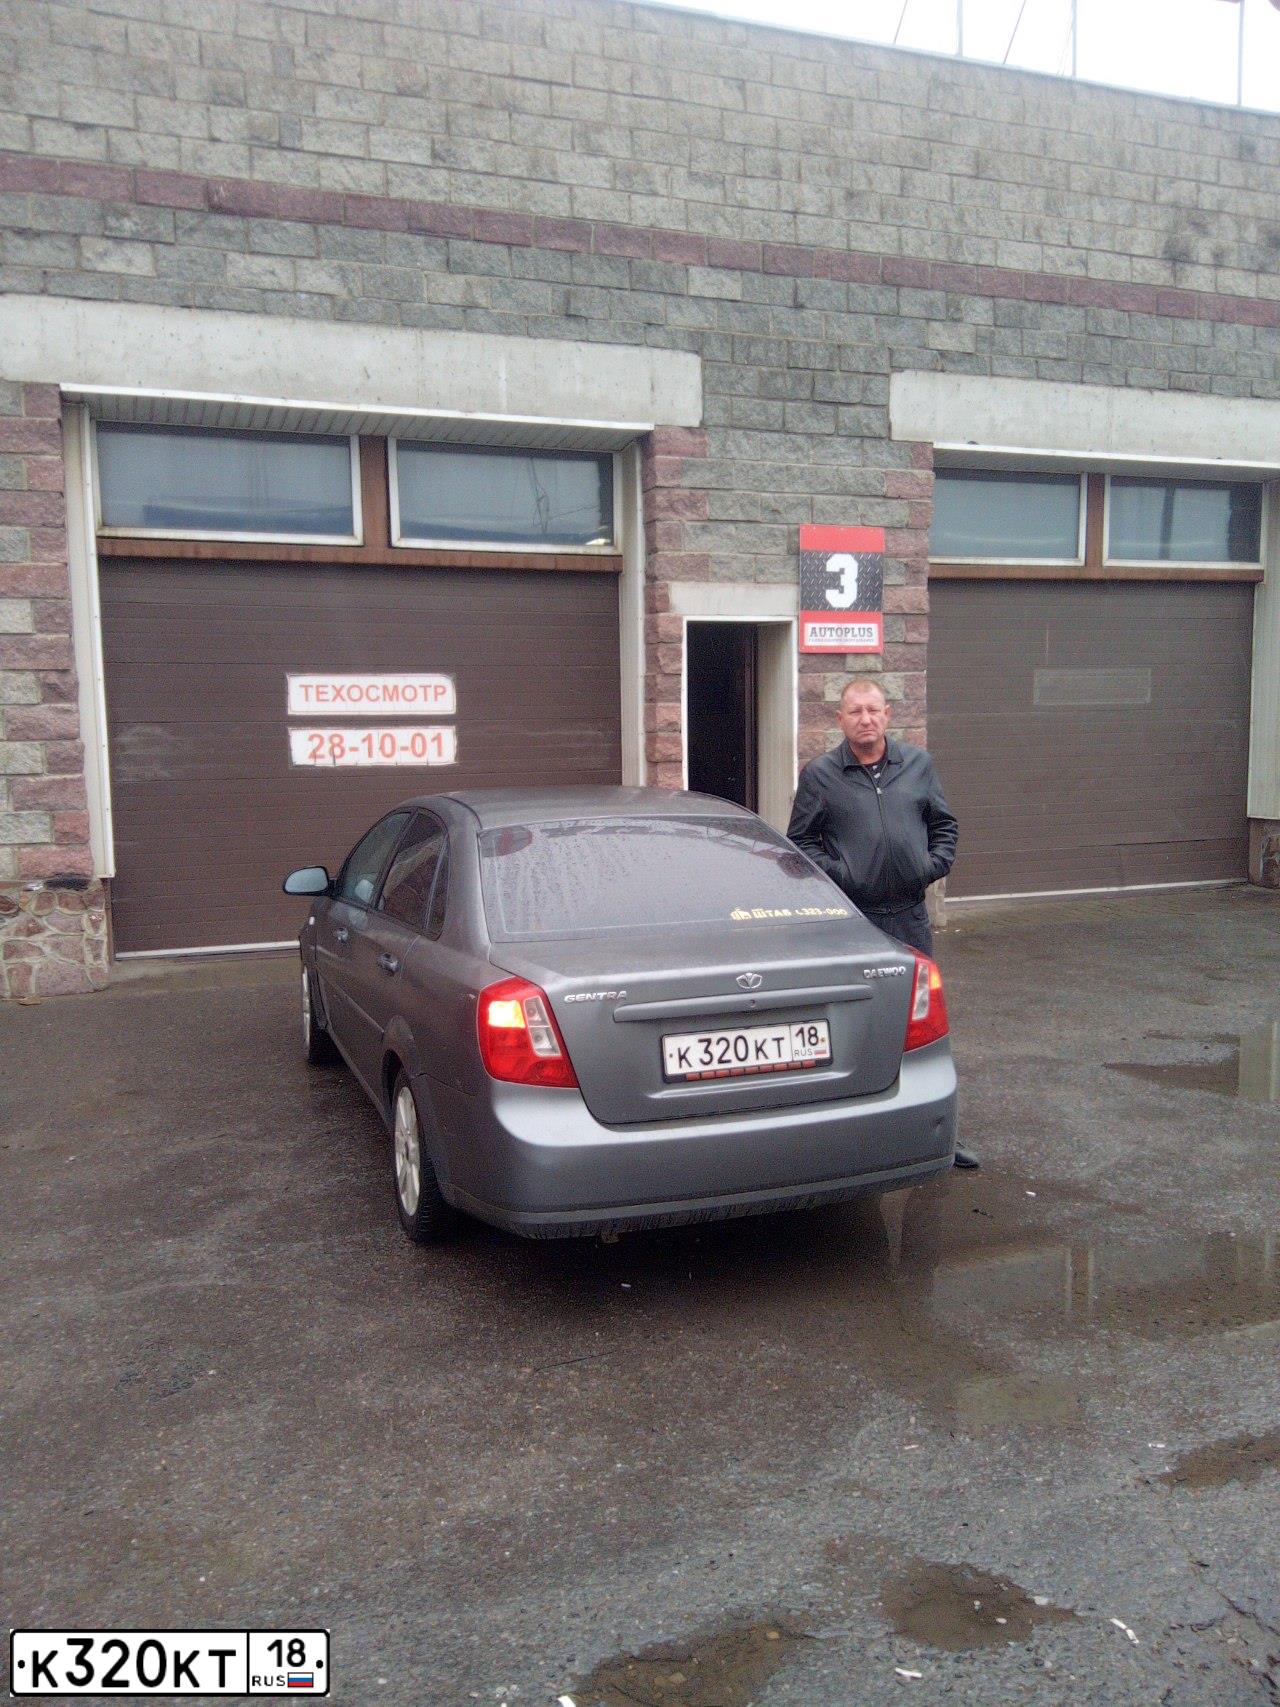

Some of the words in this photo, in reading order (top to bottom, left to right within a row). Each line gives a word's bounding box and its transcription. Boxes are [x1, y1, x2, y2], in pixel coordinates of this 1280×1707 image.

[825, 553, 858, 608] 3
[810, 627, 873, 638] AUTOPLUS
[299, 684, 447, 702] ТЕХОСМОТР
[307, 732, 444, 760] 28-10-01
[863, 966, 906, 979] DAEWOO
[564, 991, 627, 1003] GENTRA
[795, 1026, 819, 1048] 18
[794, 1048, 813, 1058] RUS
